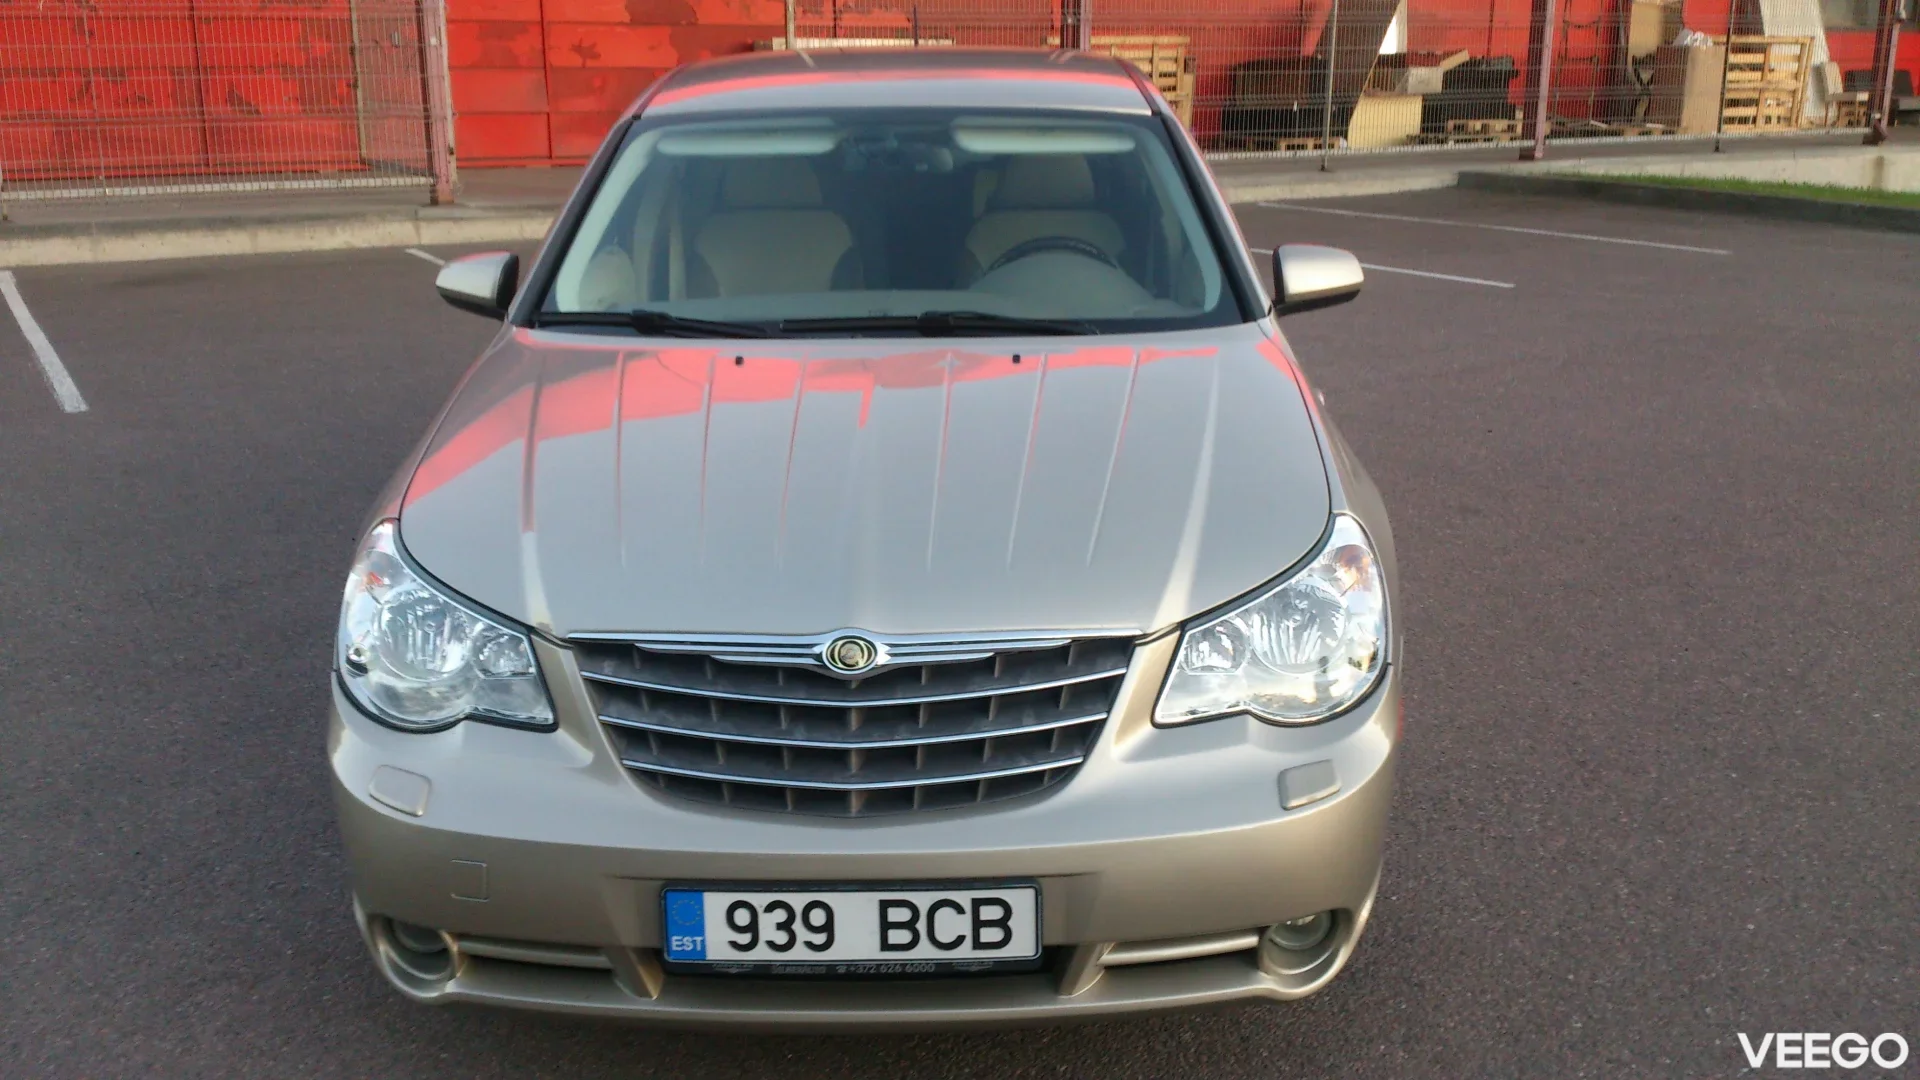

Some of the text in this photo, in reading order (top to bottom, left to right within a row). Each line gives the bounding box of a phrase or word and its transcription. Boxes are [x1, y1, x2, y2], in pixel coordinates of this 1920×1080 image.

[725, 897, 1014, 953] 939 BCB
[671, 935, 704, 951] EST
[880, 963, 902, 974] 626
[905, 962, 935, 973] 6000
